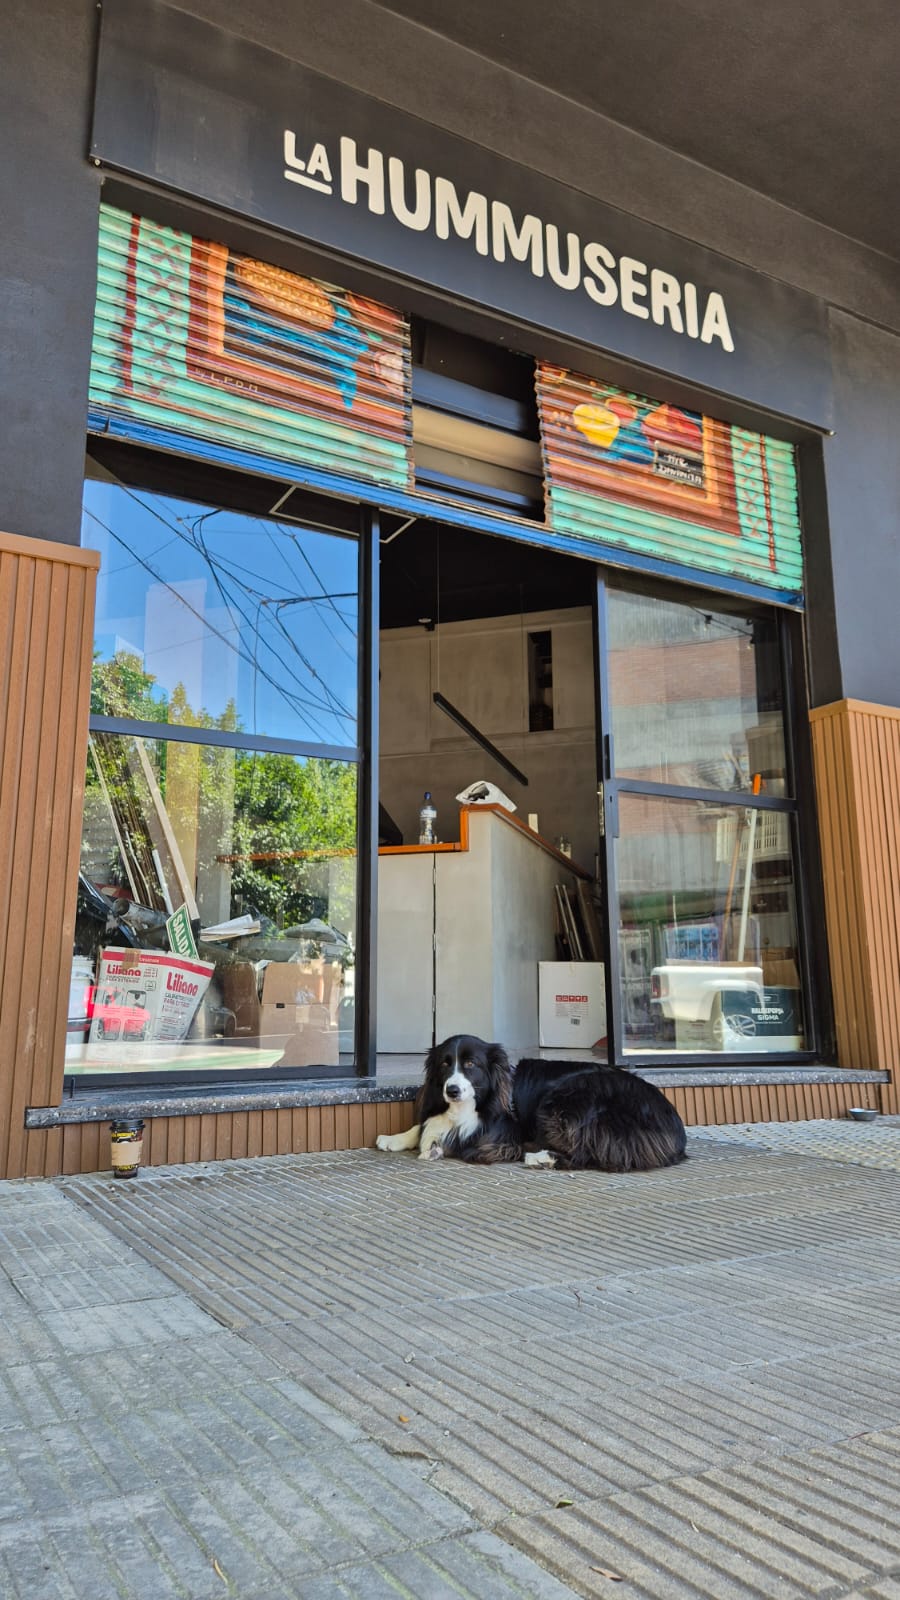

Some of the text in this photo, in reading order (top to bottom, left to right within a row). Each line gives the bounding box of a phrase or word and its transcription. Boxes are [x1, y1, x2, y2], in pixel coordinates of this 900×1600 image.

[283, 129, 735, 353] LA HUMMUSERIA
[166, 971, 199, 997] Liliana
